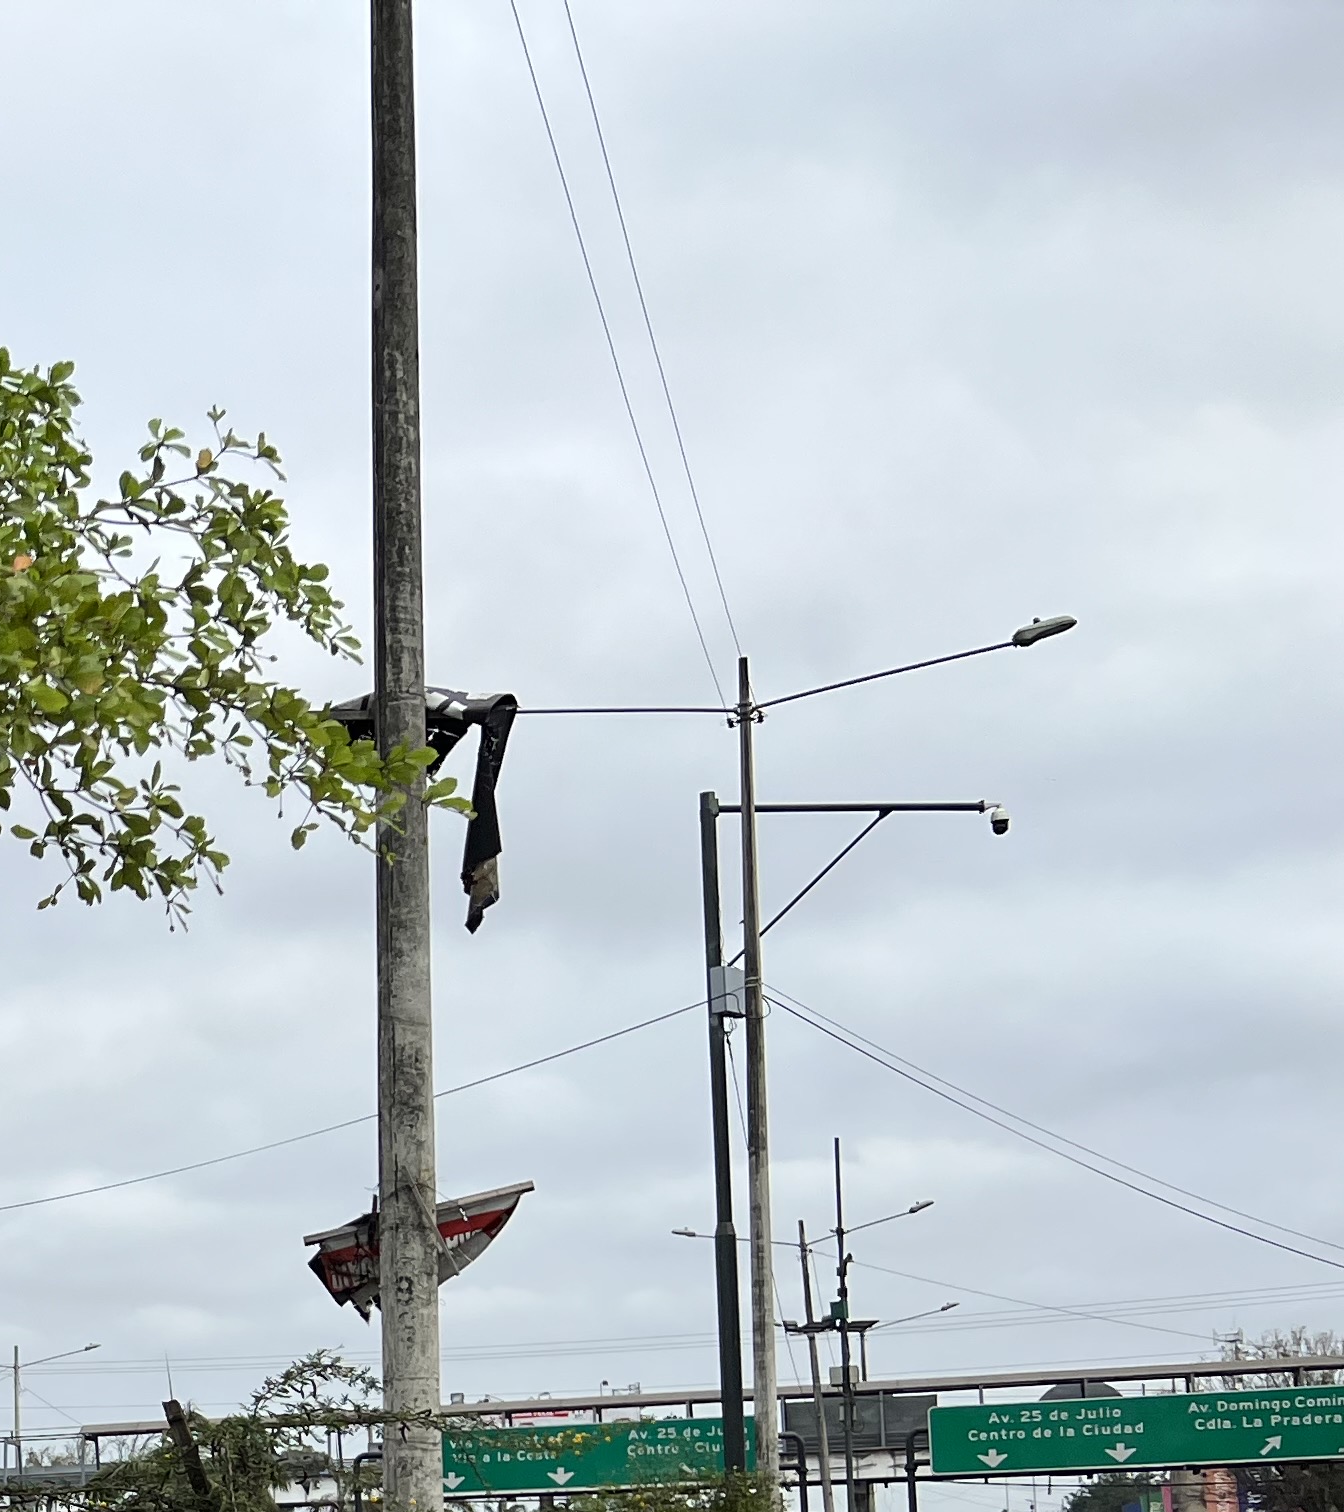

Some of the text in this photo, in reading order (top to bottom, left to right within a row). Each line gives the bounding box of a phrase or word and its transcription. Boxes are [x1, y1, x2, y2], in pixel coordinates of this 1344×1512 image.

[1188, 1402, 1212, 1414] Av.
[1217, 1398, 1291, 1412] Domingo
[988, 1406, 1122, 1424] Av. 25 de Julio
[1194, 1413, 1343, 1430] Cdla. La Pradera
[657, 1427, 677, 1439] 25
[683, 1426, 701, 1438] de
[968, 1422, 1144, 1442] Centro de la Ciudad
[483, 1453, 490, 1463] a
[497, 1451, 510, 1462] la
